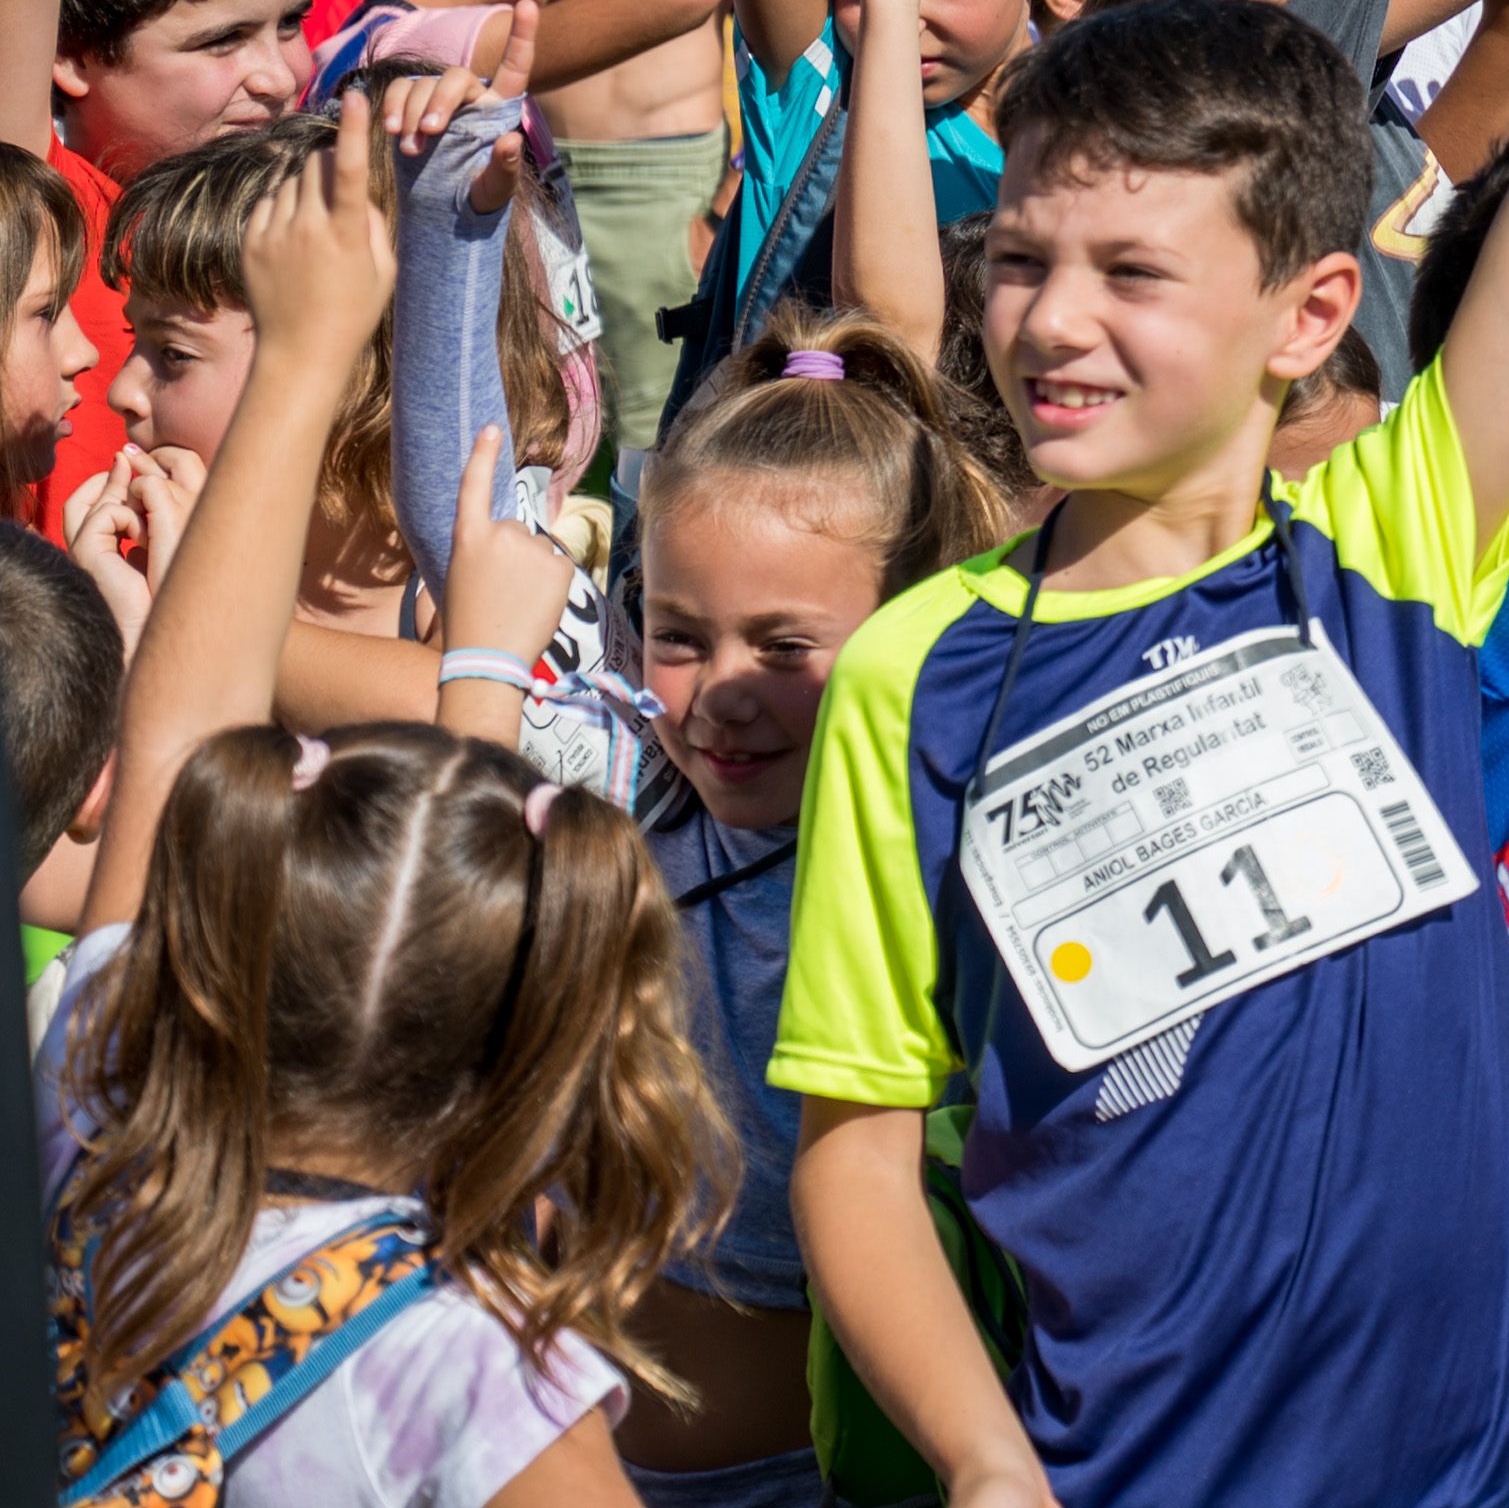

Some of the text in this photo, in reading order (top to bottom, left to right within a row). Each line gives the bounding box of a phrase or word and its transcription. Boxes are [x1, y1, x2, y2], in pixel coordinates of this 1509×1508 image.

[1083, 679, 1263, 773] 52 Marxa Infantil
[1086, 664, 1220, 734] NO EM PLASTIFIQUIS
[1111, 770, 1141, 794] de
[1083, 792, 1266, 892] ANIOL BAGES GARCÍA
[1142, 844, 1312, 990] 11
